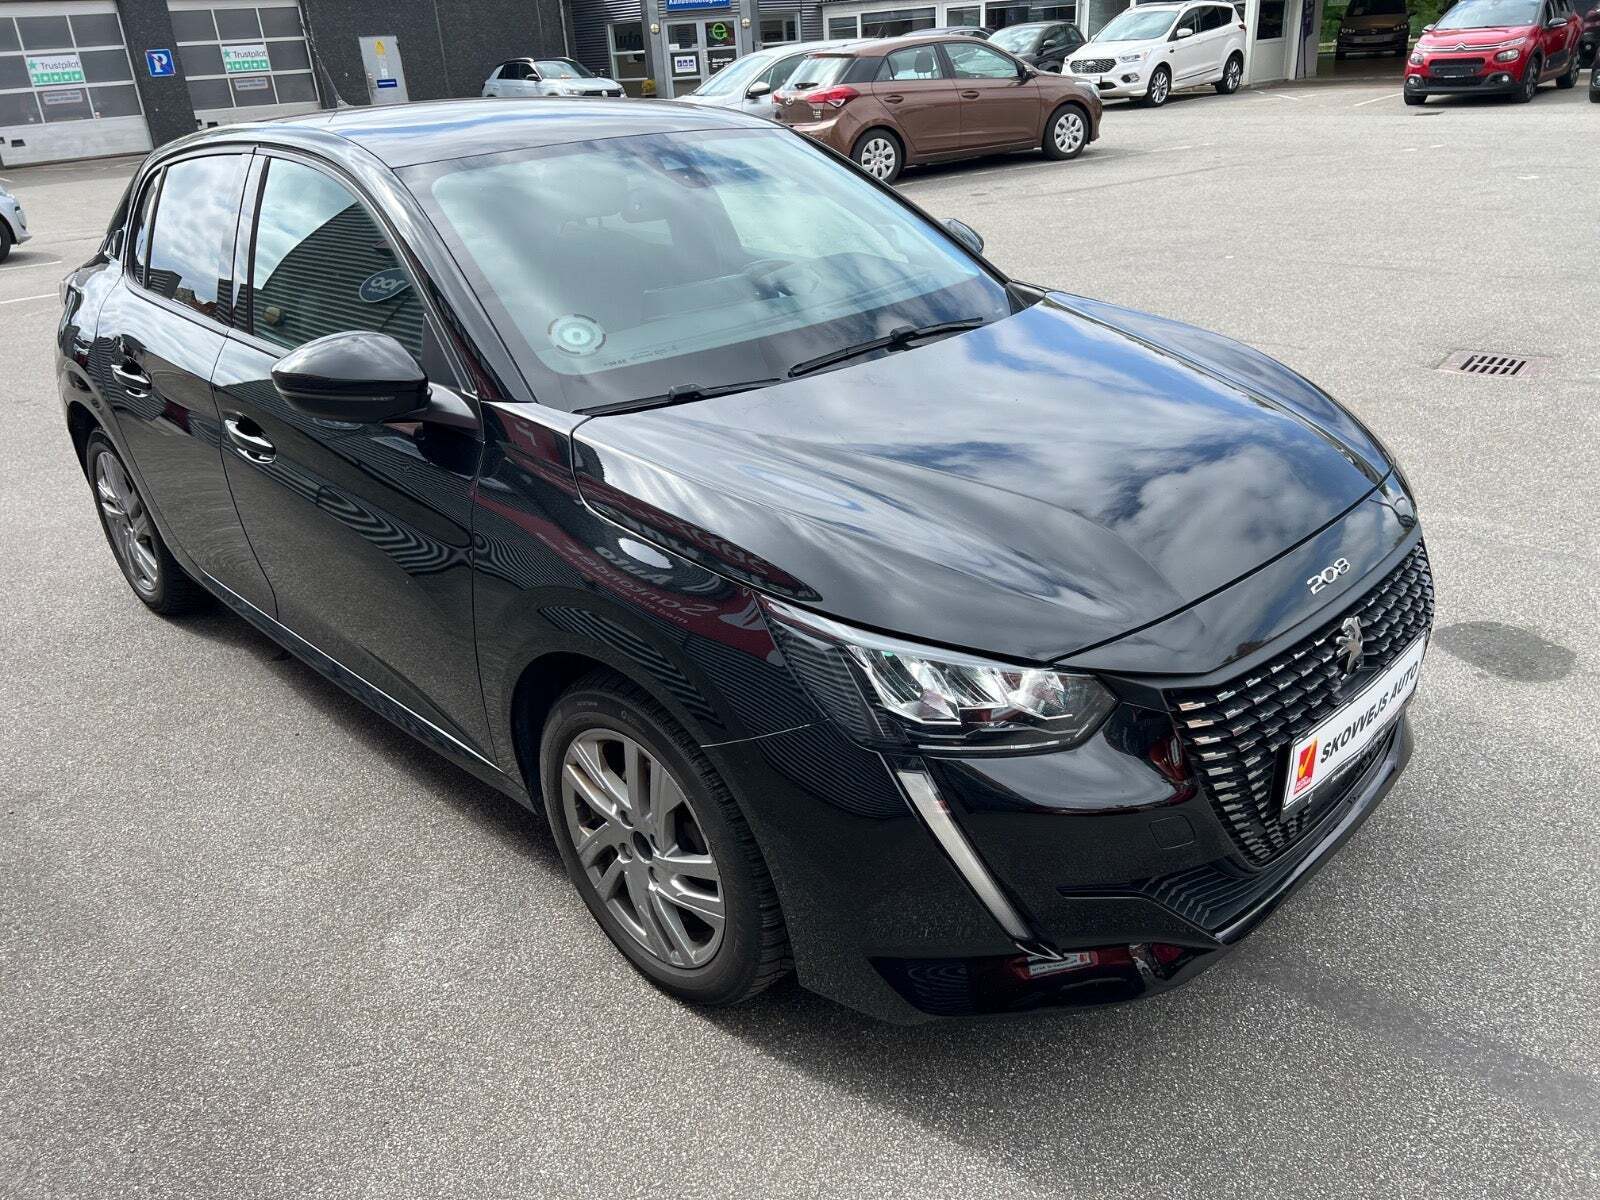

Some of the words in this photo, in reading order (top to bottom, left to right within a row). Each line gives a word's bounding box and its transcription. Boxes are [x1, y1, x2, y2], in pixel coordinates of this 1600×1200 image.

[151, 53, 167, 72] P
[233, 49, 267, 60] Trustpilot
[40, 60, 80, 71] Trustpilot
[1307, 557, 1350, 595] 208
[1320, 692, 1388, 764] SKOVVEJS
[1389, 660, 1418, 703] AUTO
